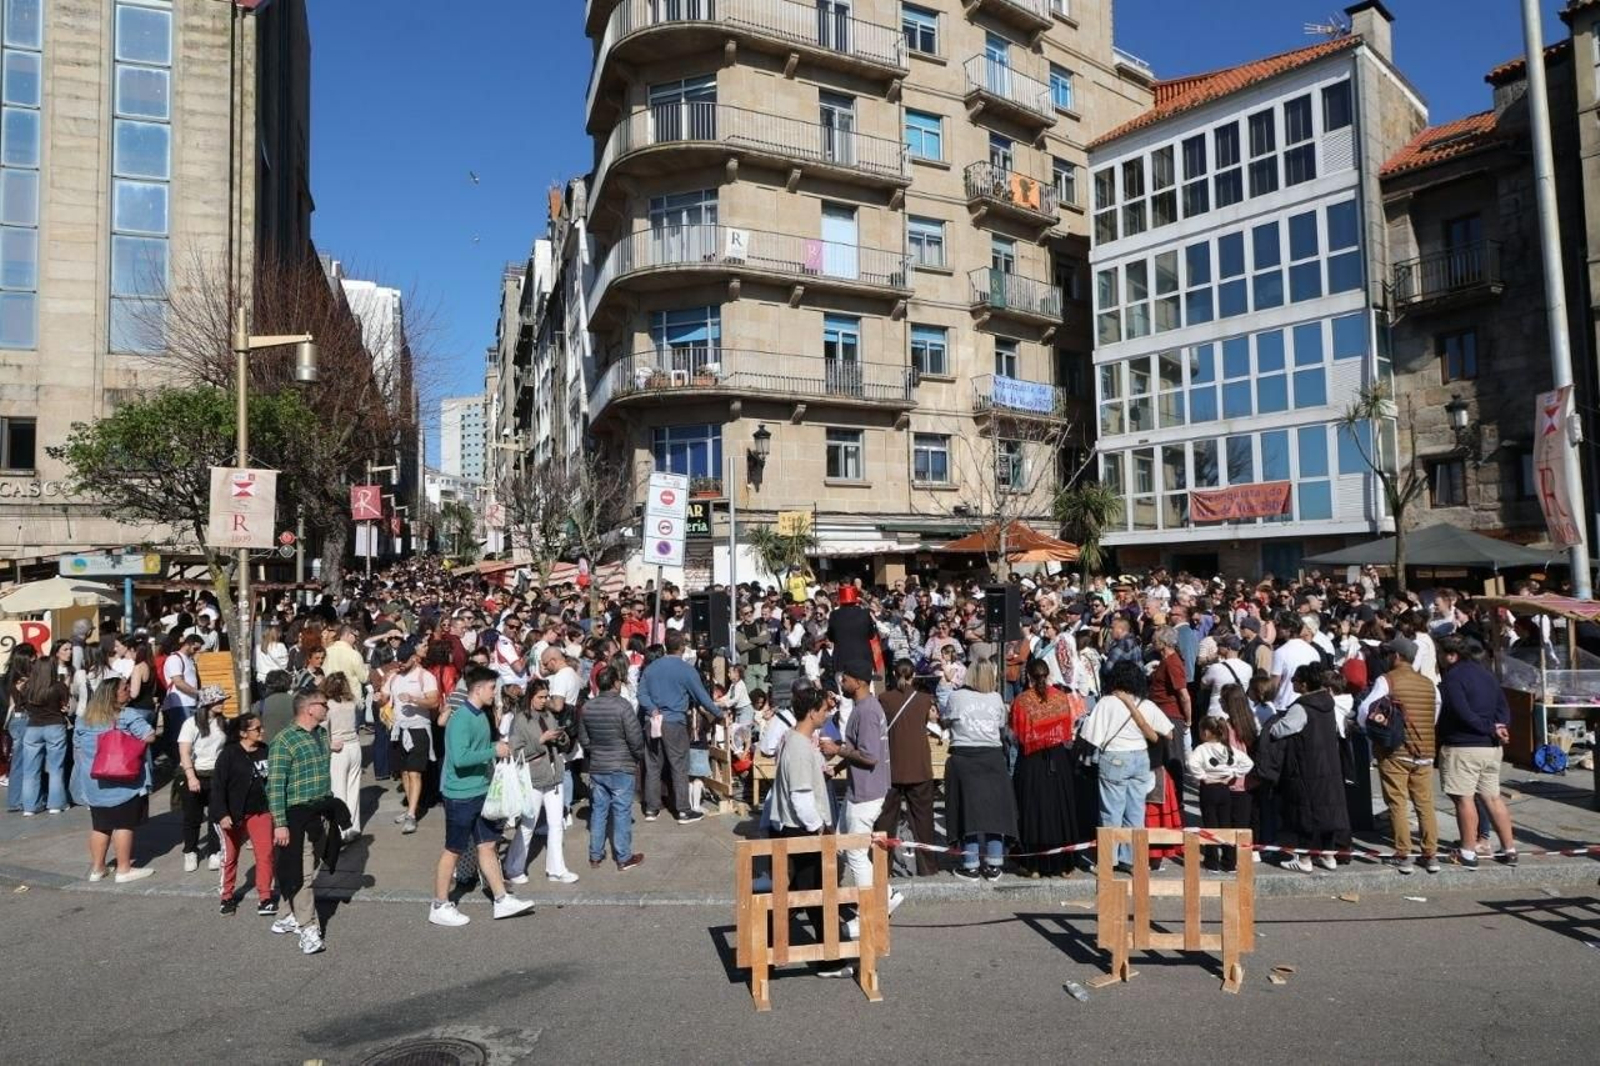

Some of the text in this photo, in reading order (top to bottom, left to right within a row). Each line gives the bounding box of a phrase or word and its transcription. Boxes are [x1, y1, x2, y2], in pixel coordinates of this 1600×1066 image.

[731, 231, 742, 246] R
[355, 490, 380, 516] R
[1539, 467, 1568, 517] R
[234, 514, 249, 532] R
[20, 623, 51, 658] R
